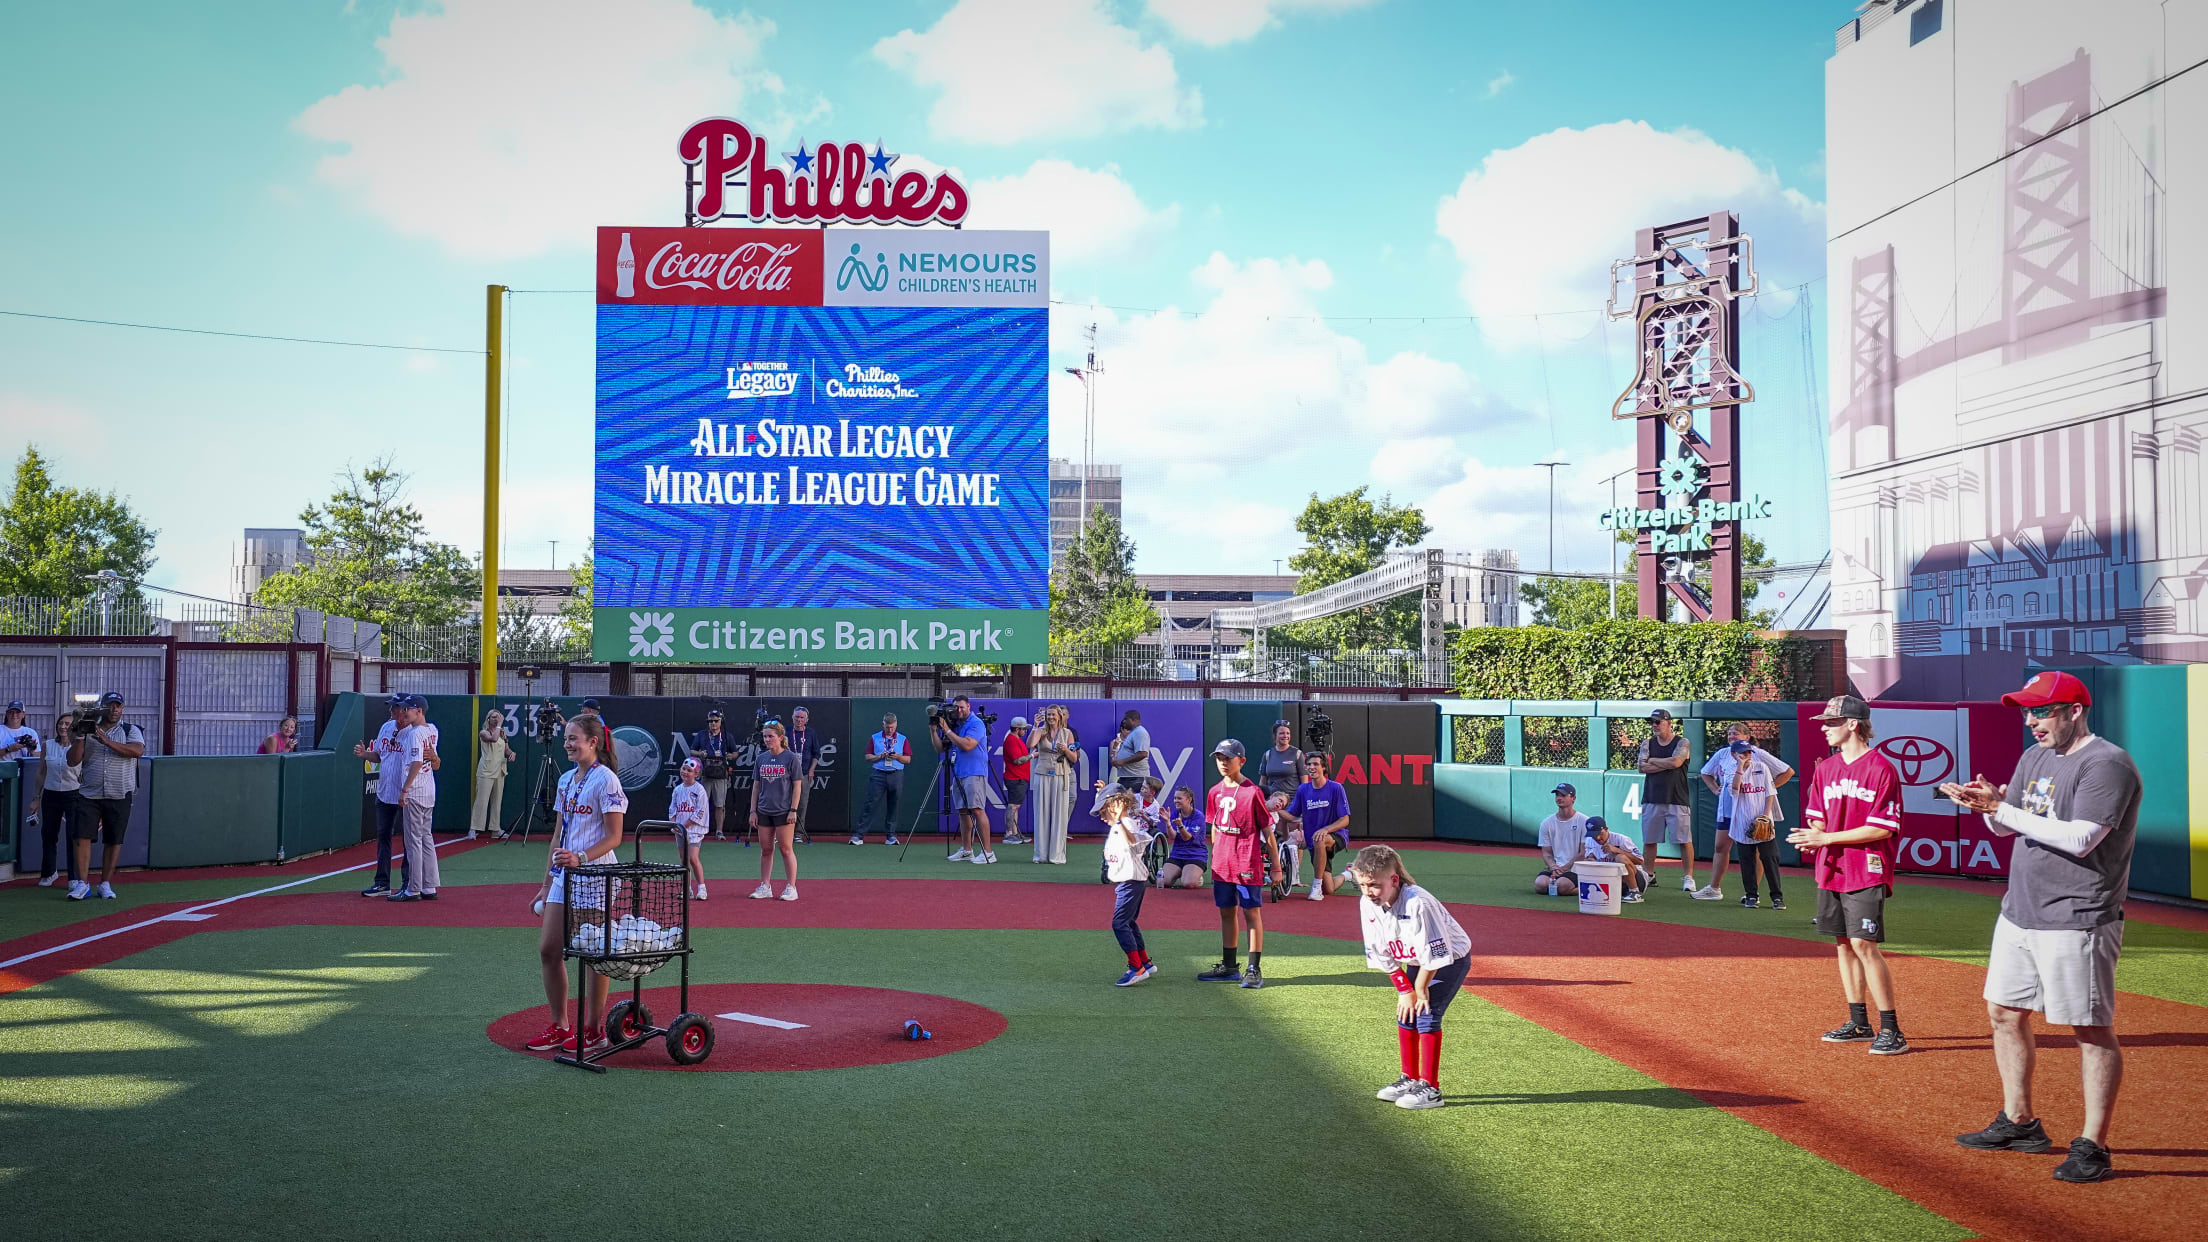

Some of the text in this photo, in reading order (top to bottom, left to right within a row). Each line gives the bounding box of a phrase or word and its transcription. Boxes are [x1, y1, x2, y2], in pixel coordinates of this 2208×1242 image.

[677, 116, 971, 226] Phillies
[645, 241, 802, 290] Coca-Cola
[898, 252, 1037, 274] NEMOURS
[898, 278, 1038, 294] CHILDREN'S HEALTH
[727, 368, 799, 394] Legacy
[753, 362, 789, 371] TOGETHER
[845, 363, 900, 383] Phillies
[839, 419, 955, 458] LEGACY
[644, 465, 1001, 506] MIRACLE LEAGUE GAME
[1598, 493, 1772, 531] Citizens Bank
[1651, 523, 1713, 553] Park
[688, 619, 827, 651] Citizens
[834, 620, 919, 651] Bank
[1327, 753, 1433, 785] ANT
[1896, 836, 2002, 870] YOTA
